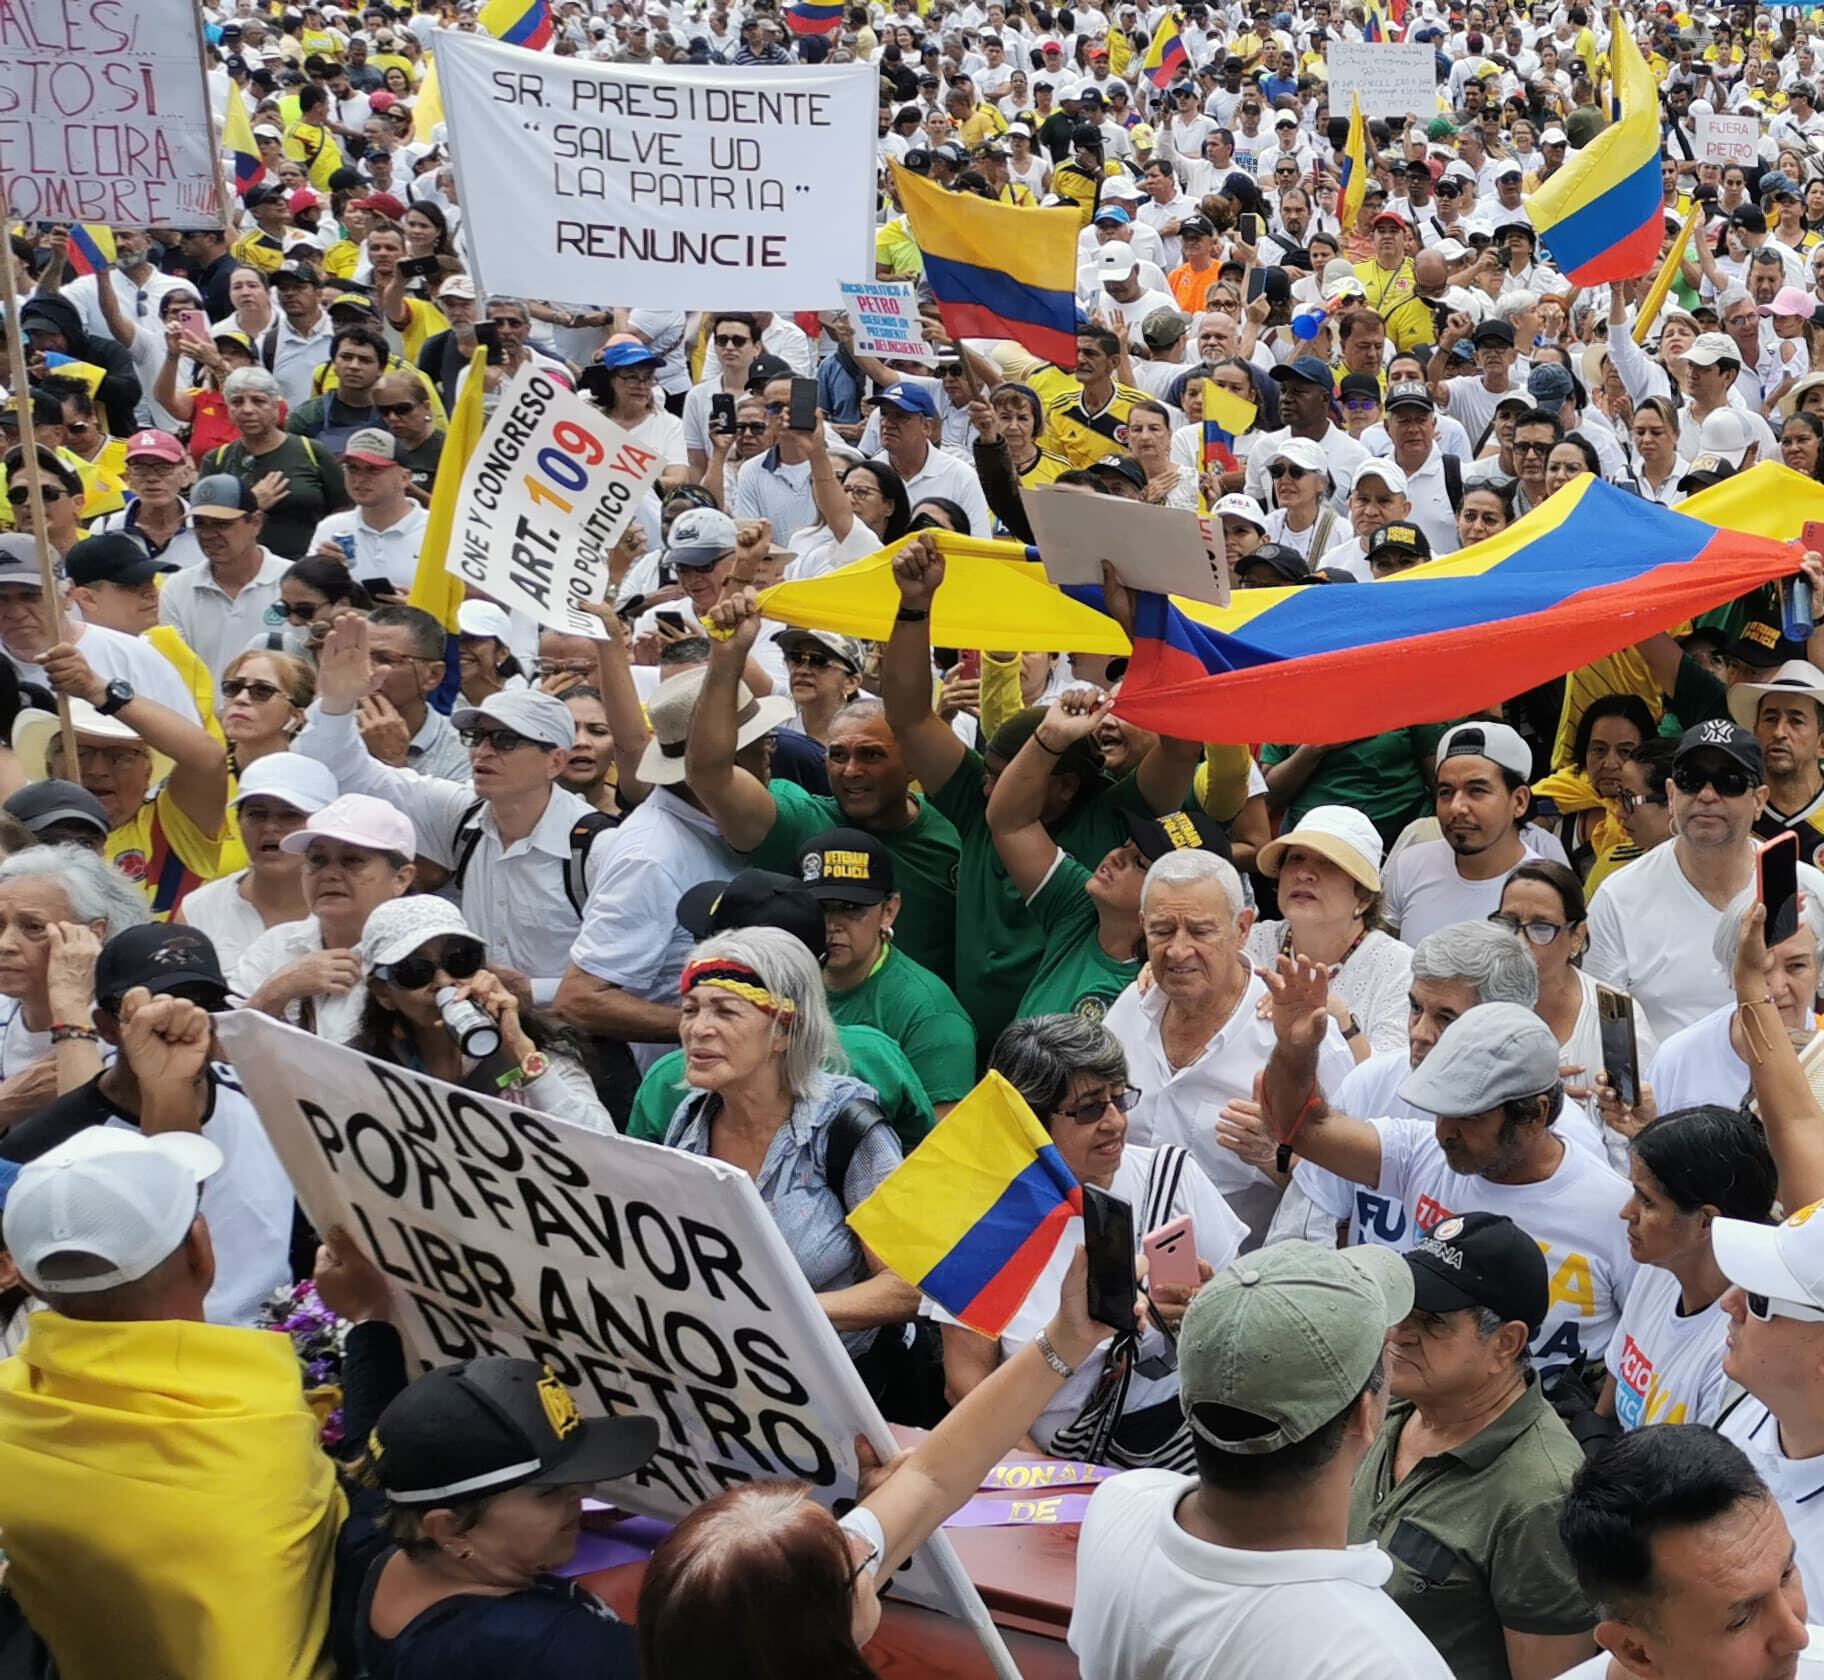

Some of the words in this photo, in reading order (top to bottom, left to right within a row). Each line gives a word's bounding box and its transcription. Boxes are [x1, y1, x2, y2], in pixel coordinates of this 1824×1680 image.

[492, 71, 552, 108] SR.
[573, 79, 831, 126] PRESIDENTE
[711, 136, 761, 171] UD
[1706, 142, 1753, 158] PETRO
[1708, 121, 1750, 135] FUERA
[554, 163, 606, 200] LA
[556, 220, 787, 267] RENUNCIE
[857, 296, 900, 315] PETRO
[474, 376, 555, 511] CONGRESO
[523, 420, 606, 515] 109
[468, 508, 493, 531] Y
[576, 480, 631, 578] POLÍTICO
[610, 444, 657, 481] YA
[461, 528, 491, 582] CNE
[509, 514, 561, 611] ART.
[366, 1060, 590, 1187] DIOS
[351, 1202, 810, 1406] LIBRANOS
[523, 1336, 836, 1487] PETRO
[1007, 1498, 1063, 1522] DE
